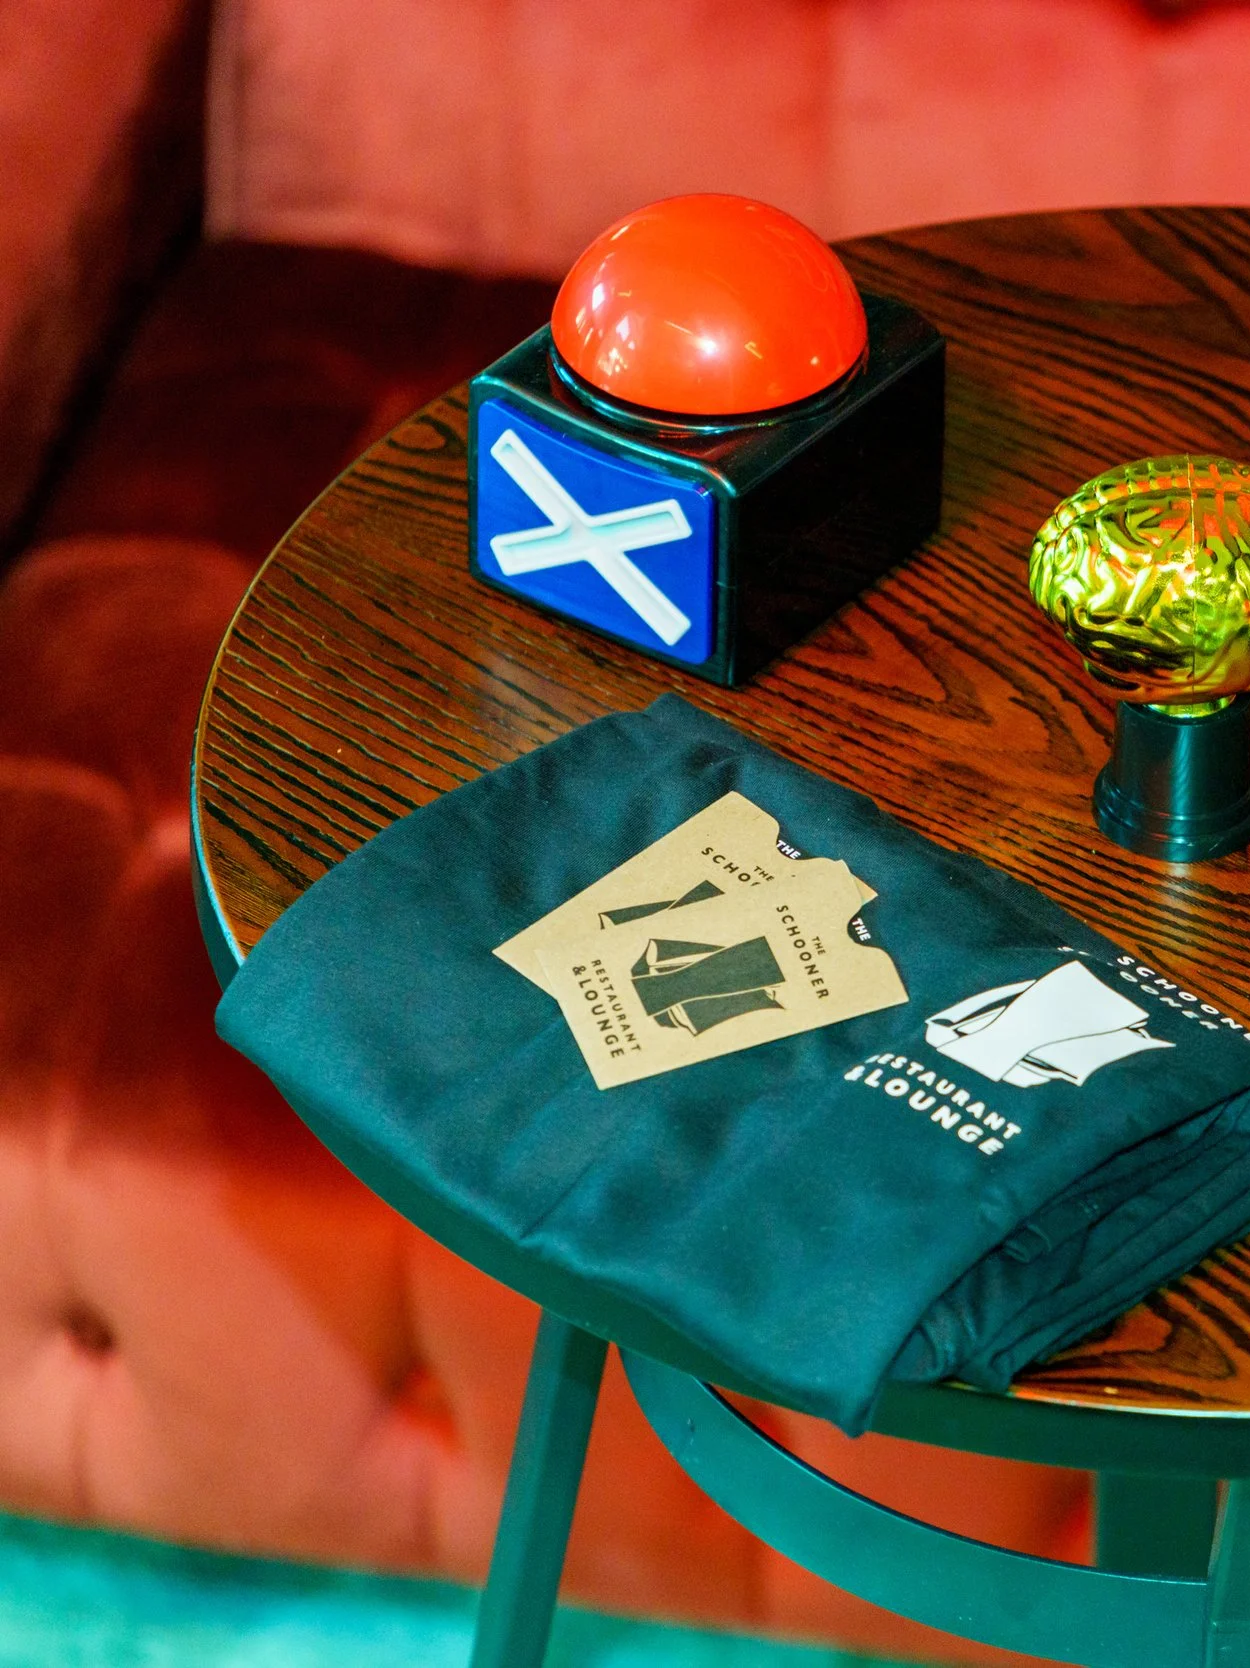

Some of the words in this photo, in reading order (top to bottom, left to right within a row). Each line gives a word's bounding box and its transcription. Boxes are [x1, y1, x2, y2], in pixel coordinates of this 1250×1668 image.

[776, 840, 801, 860] THE
[701, 846, 760, 887] SCHO
[753, 865, 775, 882] THE
[852, 917, 872, 942] THE
[776, 904, 830, 999] SCHOONER
[811, 936, 826, 956] THE
[591, 959, 641, 1052] RESTAURANT
